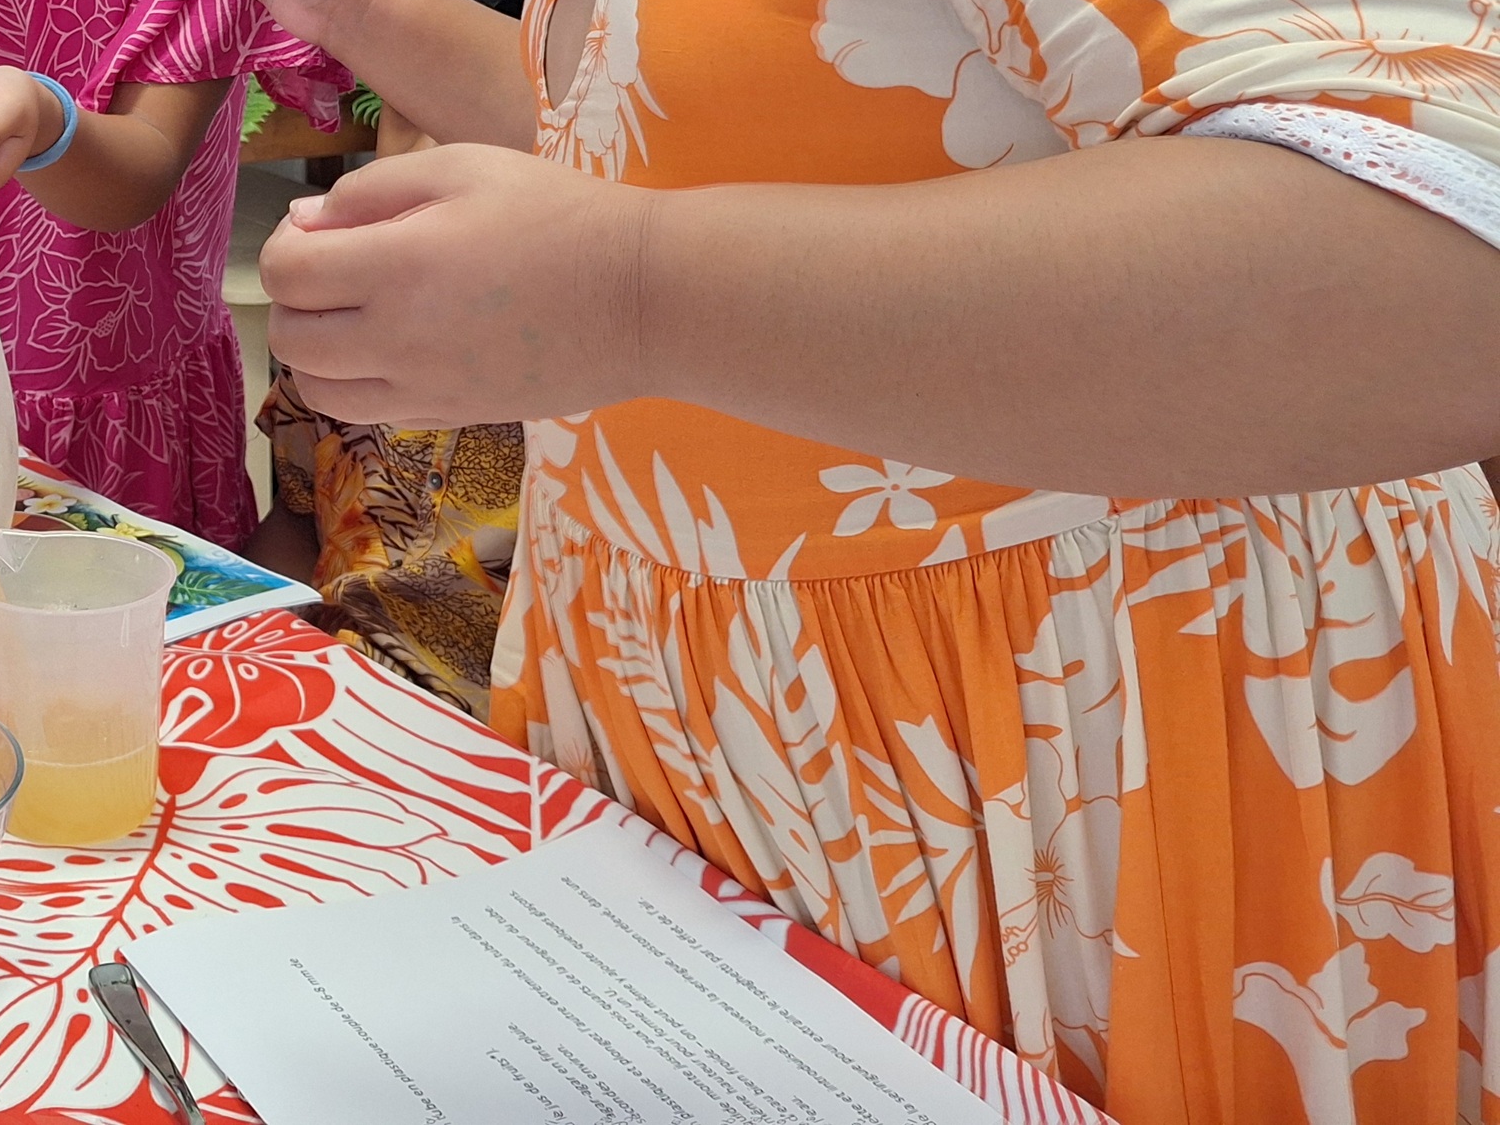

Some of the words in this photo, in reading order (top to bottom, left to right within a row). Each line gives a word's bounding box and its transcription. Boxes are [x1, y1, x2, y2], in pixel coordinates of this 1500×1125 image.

[560, 876, 580, 891] une
[578, 890, 602, 908] dans
[450, 916, 461, 924] la
[504, 924, 519, 934] du
[657, 914, 673, 925] de
[459, 923, 482, 940] dans
[541, 917, 583, 950] quelques
[670, 924, 702, 950] l'effet
[479, 940, 503, 958] tube
[516, 935, 558, 966] longueur
[631, 933, 665, 957] piston
[289, 958, 303, 969] de
[500, 957, 515, 968] du
[581, 951, 618, 976] ajouter
[699, 949, 723, 963] par
[300, 969, 319, 985] mm
[556, 966, 568, 974] la
[565, 974, 581, 985] de
[512, 969, 559, 1005] extrémité
[716, 963, 769, 1000] spaghetti
[313, 986, 333, 1000] 6-8
[579, 985, 612, 1010] quarts
[616, 997, 632, 1008] un
[623, 984, 656, 1008] même
[706, 992, 720, 1002] la
[329, 1001, 344, 1012] de
[767, 1000, 780, 1010] le
[341, 1014, 372, 1041] souple
[557, 1006, 591, 1032] l'autre
[609, 1010, 635, 1030] trois
[629, 1009, 667, 1037] former
[653, 1008, 683, 1028] peut
[718, 1001, 765, 1037] nouveau
[778, 1009, 823, 1042] extraire
[679, 1029, 696, 1040] on
[531, 1044, 554, 1062] fine
[588, 1032, 632, 1065] plongez
[633, 1030, 687, 1069] jusqu'aux
[664, 1038, 696, 1057] pour
[821, 1044, 855, 1064] pour
[368, 1042, 414, 1082] plastique
[551, 1061, 568, 1074] en
[626, 1065, 643, 1077] et
[704, 1048, 739, 1075] froide
[773, 1044, 837, 1091] introduisez
[682, 1070, 720, 1100] monte
[691, 1059, 737, 1094] hauteur
[737, 1074, 764, 1096] bien
[851, 1064, 905, 1103] seringue
[407, 1084, 424, 1096] en
[523, 1081, 540, 1094] de
[835, 1091, 852, 1103] et
[420, 1097, 446, 1120] tube
[536, 1095, 560, 1110] jus
[595, 1081, 646, 1123] secondes
[640, 1078, 694, 1120] plastique
[735, 1095, 773, 1123] même
[762, 1095, 798, 1122] d'eau
[903, 1103, 918, 1114] la
[552, 1110, 567, 1121] le
